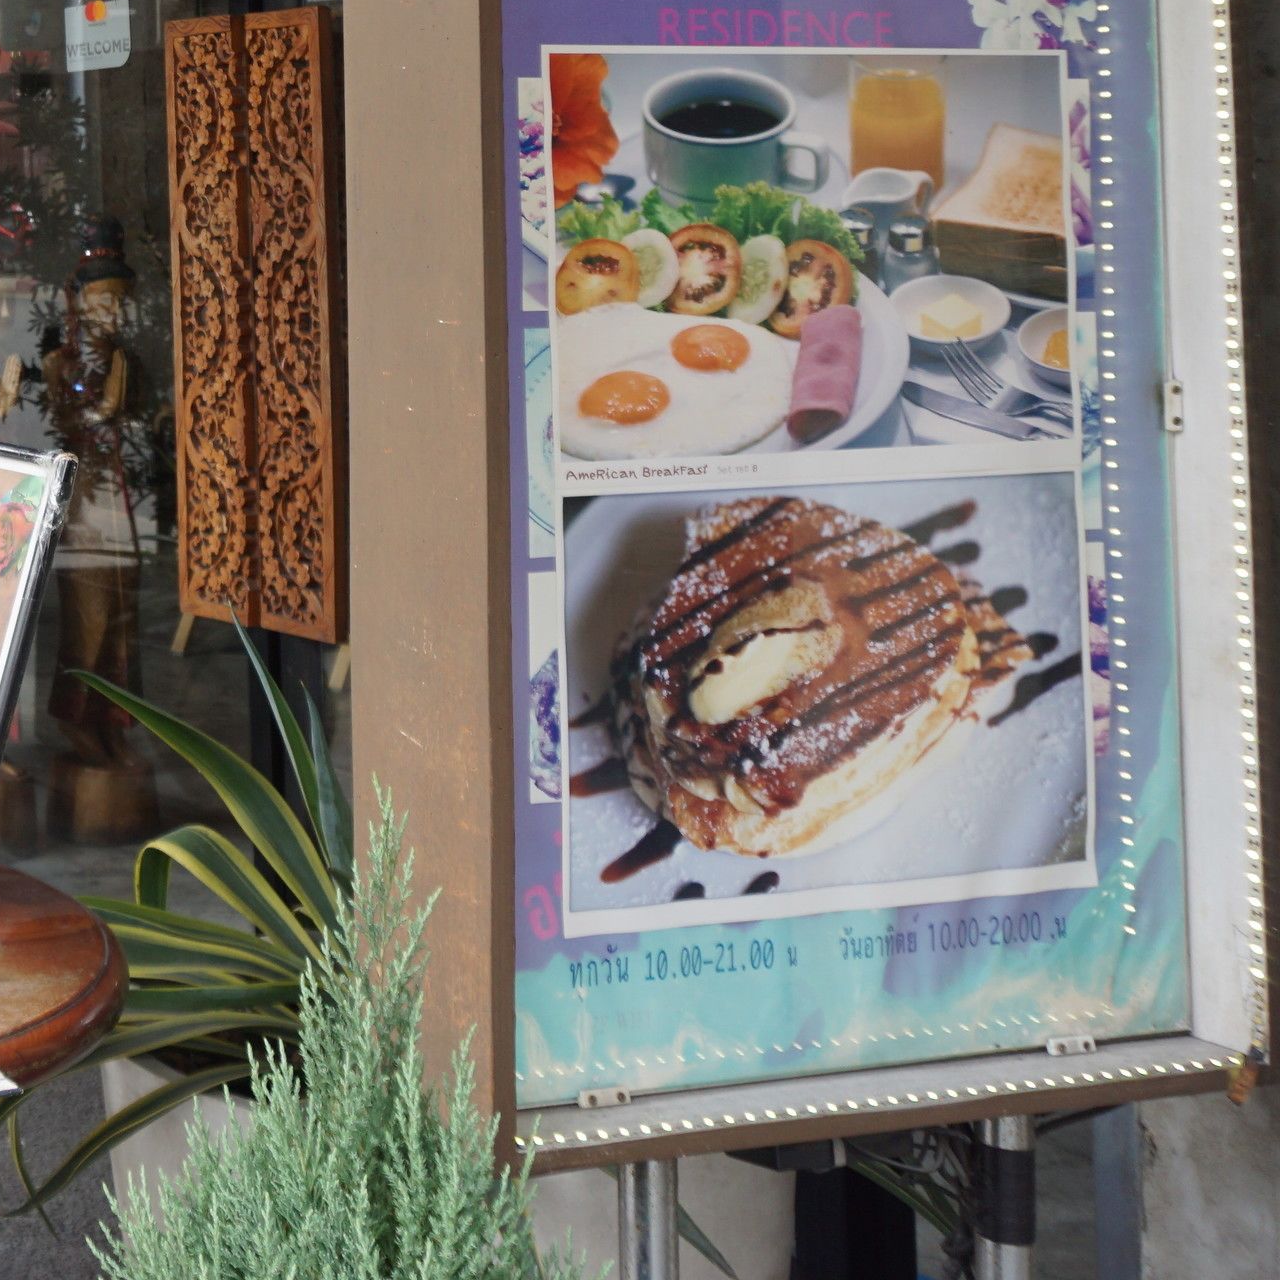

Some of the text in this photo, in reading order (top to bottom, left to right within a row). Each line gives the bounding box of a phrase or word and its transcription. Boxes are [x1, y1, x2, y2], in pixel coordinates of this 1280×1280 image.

[658, 8, 894, 48] RESIDENCE
[66, 39, 130, 58] WELCOME
[928, 911, 1042, 952] 10.00-20.00
[644, 939, 775, 981] 10.00-21.00
